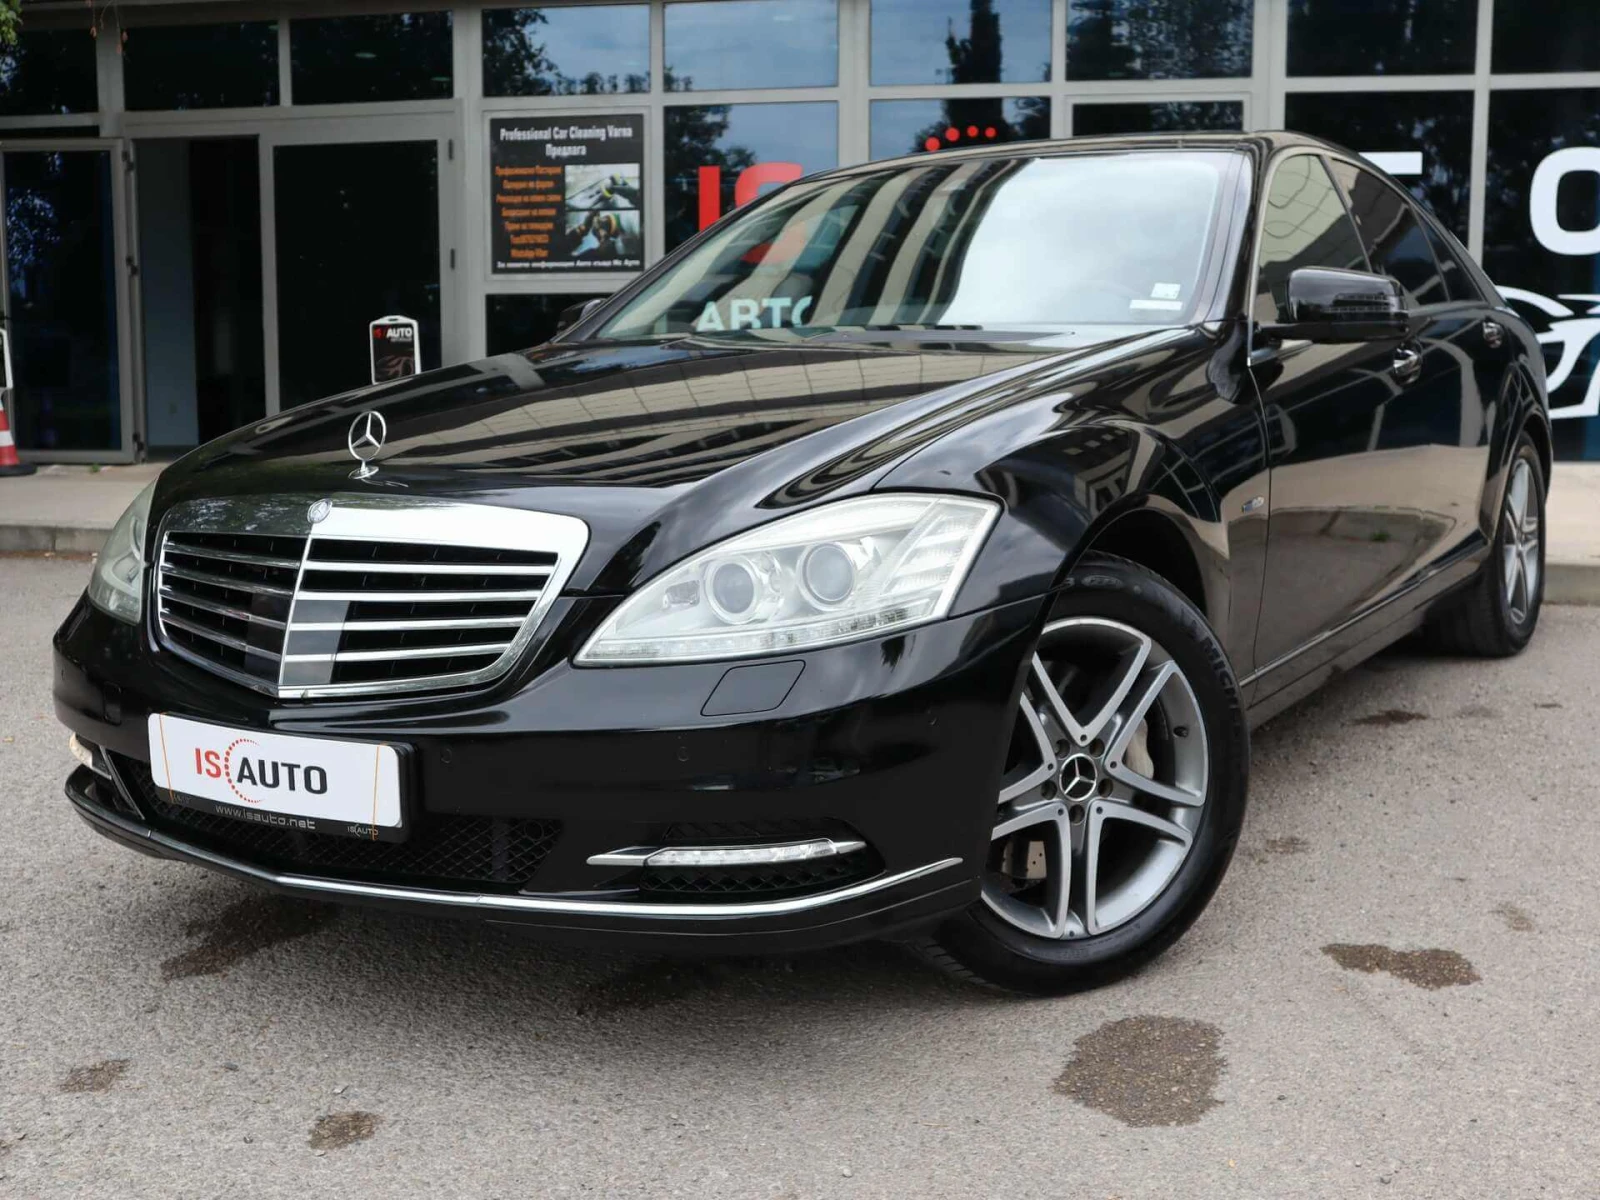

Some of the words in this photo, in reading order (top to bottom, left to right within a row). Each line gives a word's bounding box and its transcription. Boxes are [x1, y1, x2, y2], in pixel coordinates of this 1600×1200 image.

[500, 127, 551, 141] Professional
[553, 127, 568, 140] Car
[569, 125, 606, 141] Cleaning
[386, 327, 413, 338] AUTO
[195, 748, 222, 778] IS
[236, 757, 328, 794] AUTO
[215, 804, 316, 830] www.isauto.net
